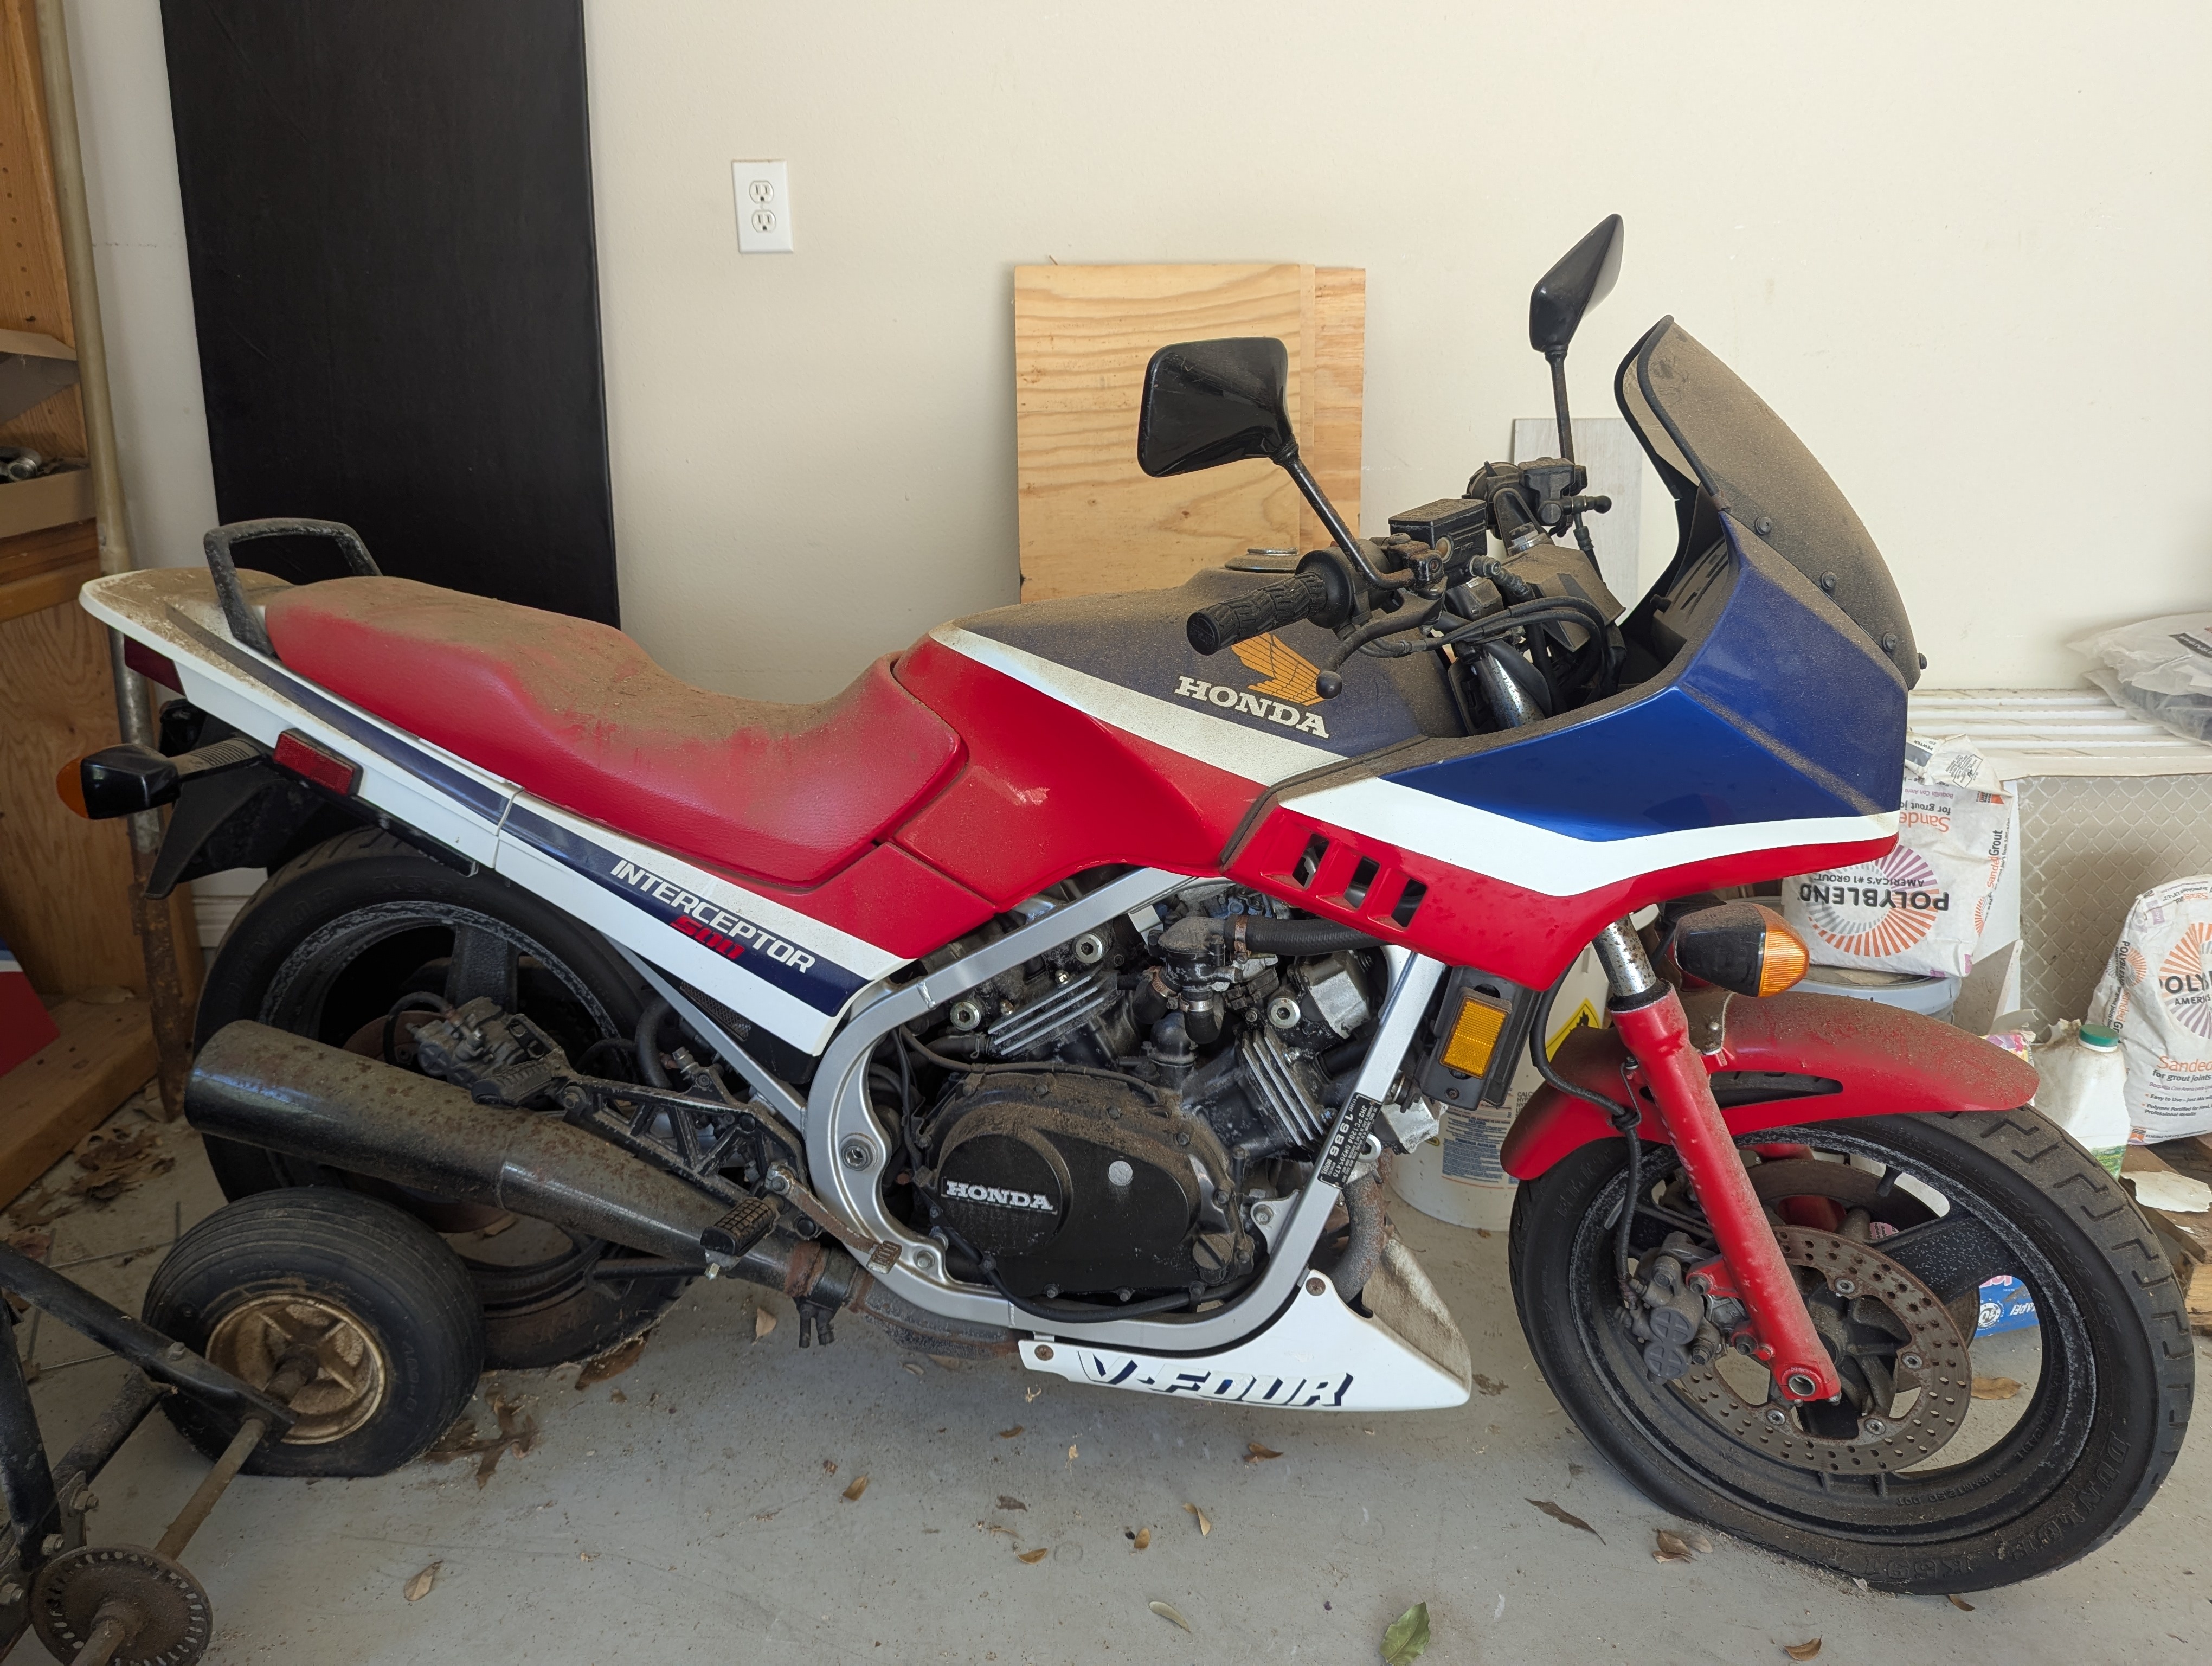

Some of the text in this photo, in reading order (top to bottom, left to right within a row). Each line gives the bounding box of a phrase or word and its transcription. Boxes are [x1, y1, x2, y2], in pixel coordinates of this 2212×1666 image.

[1174, 675, 1329, 739] HONDA
[1914, 740, 1933, 751] PEWTER
[1911, 802, 1935, 811] grout
[1937, 806, 1951, 815] for
[1989, 830, 2003, 856] Grout
[1816, 873, 1851, 883] GROUT
[1867, 877, 1925, 887] AMERICA'S
[1799, 882, 1950, 911] POLYBLEND
[610, 859, 815, 974] INTERCEPTOR
[670, 915, 745, 959] 500
[2119, 940, 2130, 988] POLYBLEND
[2152, 1069, 2166, 1079] for
[2190, 1074, 2211, 1083] joints
[2149, 1082, 2170, 1091] Boquilla
[1359, 1105, 1367, 1117] JH2
[1329, 1113, 1353, 1157] 1986
[1321, 1158, 1333, 1175] MODEL
[946, 1180, 1054, 1211] HONDA
